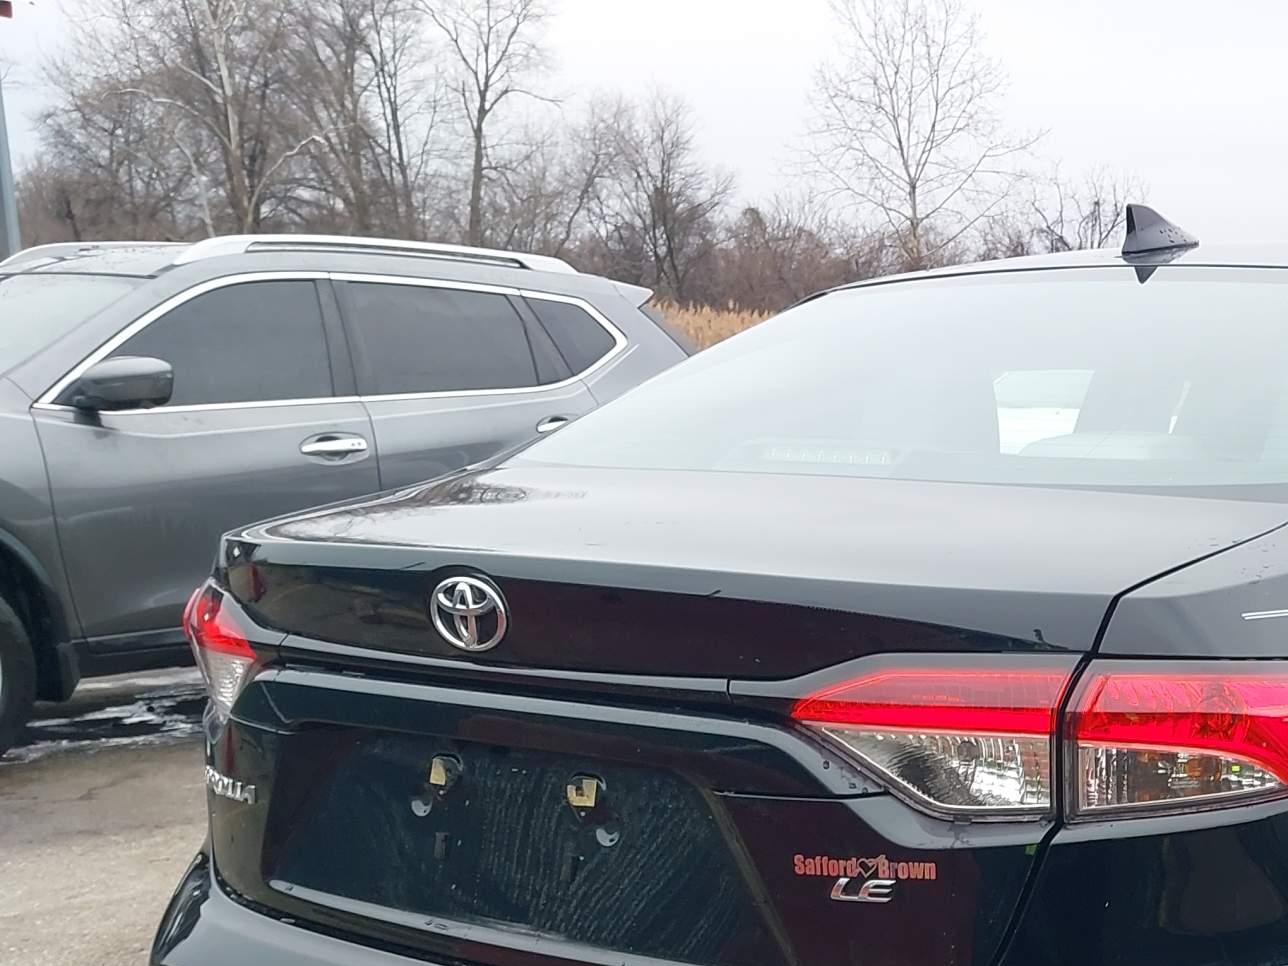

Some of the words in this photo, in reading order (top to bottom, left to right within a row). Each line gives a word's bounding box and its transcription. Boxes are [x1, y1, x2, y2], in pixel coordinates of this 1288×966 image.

[793, 854, 860, 877] Safford
[878, 855, 937, 880] Brown
[830, 877, 897, 903] LE
